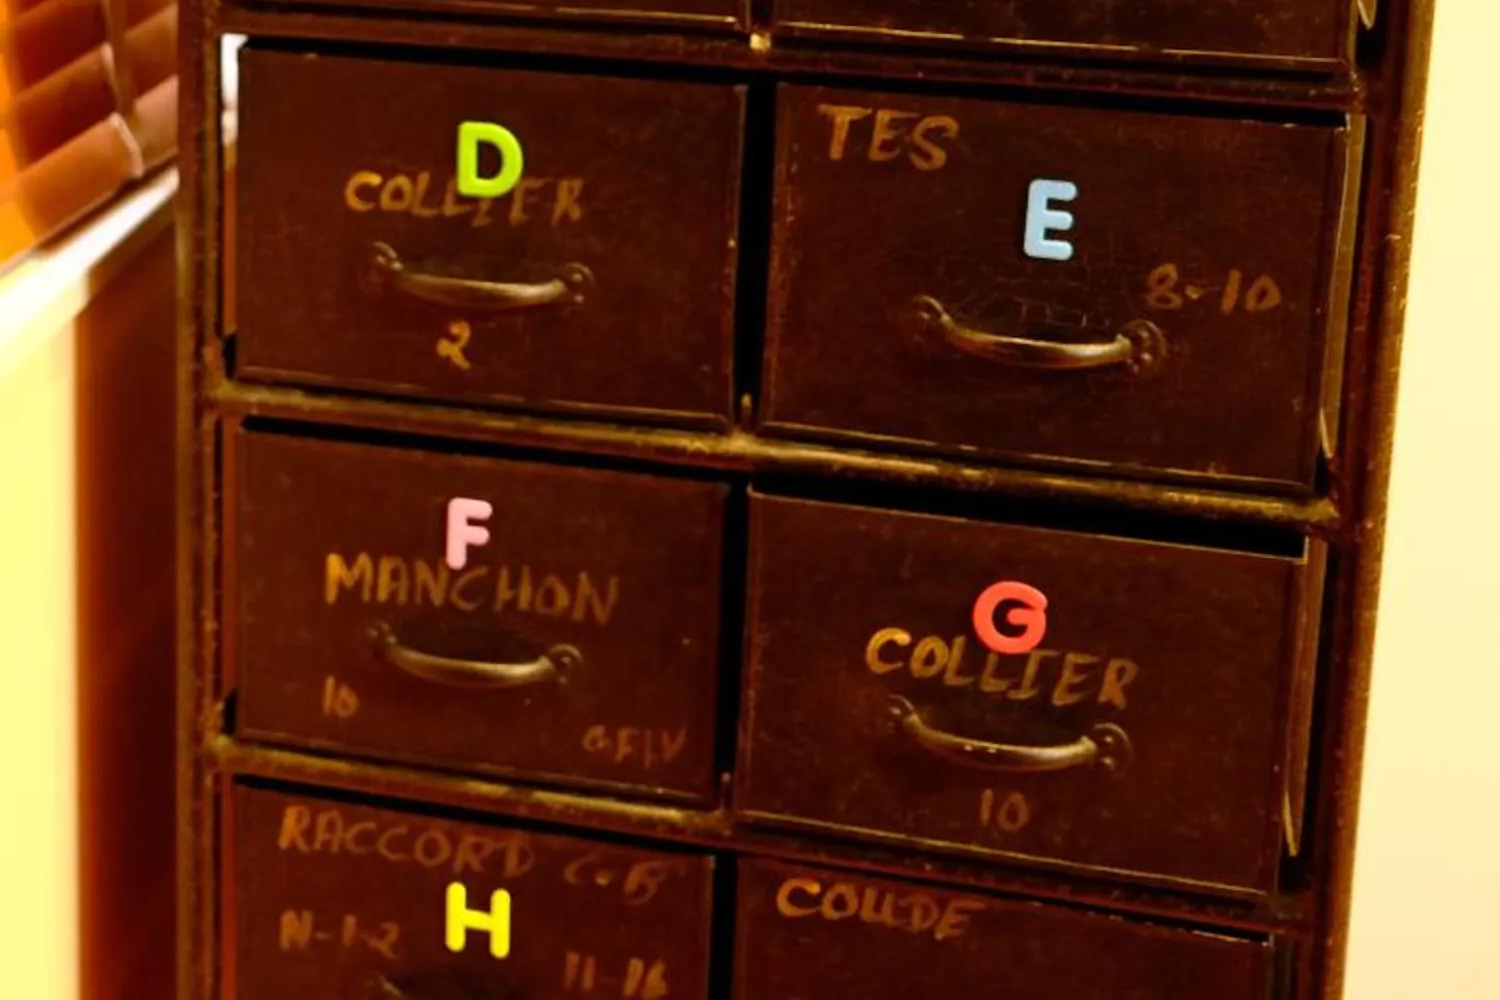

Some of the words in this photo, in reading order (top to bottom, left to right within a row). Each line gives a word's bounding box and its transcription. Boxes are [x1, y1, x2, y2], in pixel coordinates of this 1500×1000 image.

[456, 120, 524, 198] D
[817, 103, 961, 172] TES
[1023, 178, 1079, 261] E
[436, 321, 473, 371] 2
[446, 497, 493, 571] F
[325, 552, 619, 626] MANCHON
[972, 580, 1049, 655] G
[278, 804, 534, 879] RACCORD
[979, 788, 1030, 833] 10
[445, 881, 512, 959] H
[776, 876, 985, 940] COUDE
